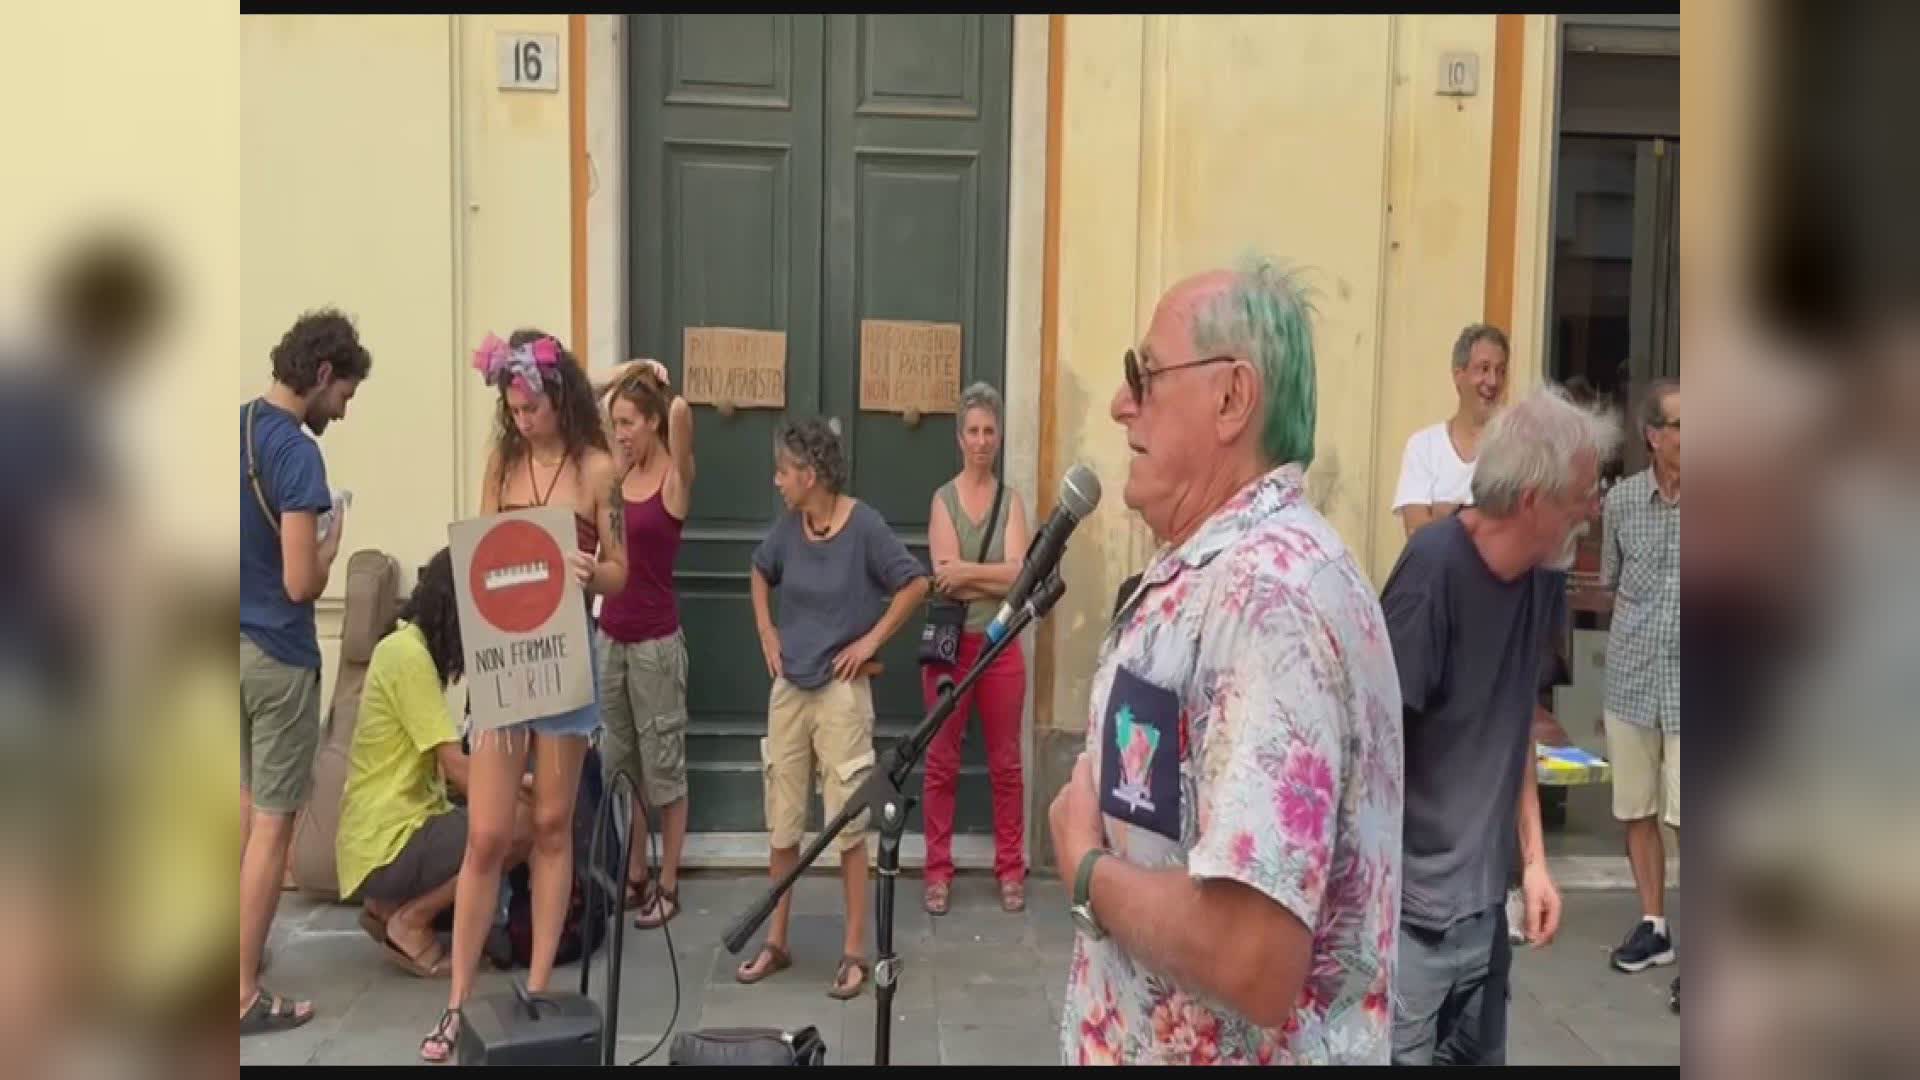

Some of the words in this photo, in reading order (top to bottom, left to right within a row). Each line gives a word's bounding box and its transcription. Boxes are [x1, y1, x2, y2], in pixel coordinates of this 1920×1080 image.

[513, 40, 542, 82] 16
[898, 352, 953, 378] PARTE
[474, 647, 506, 674] NON
[510, 631, 569, 665] FERMATE
